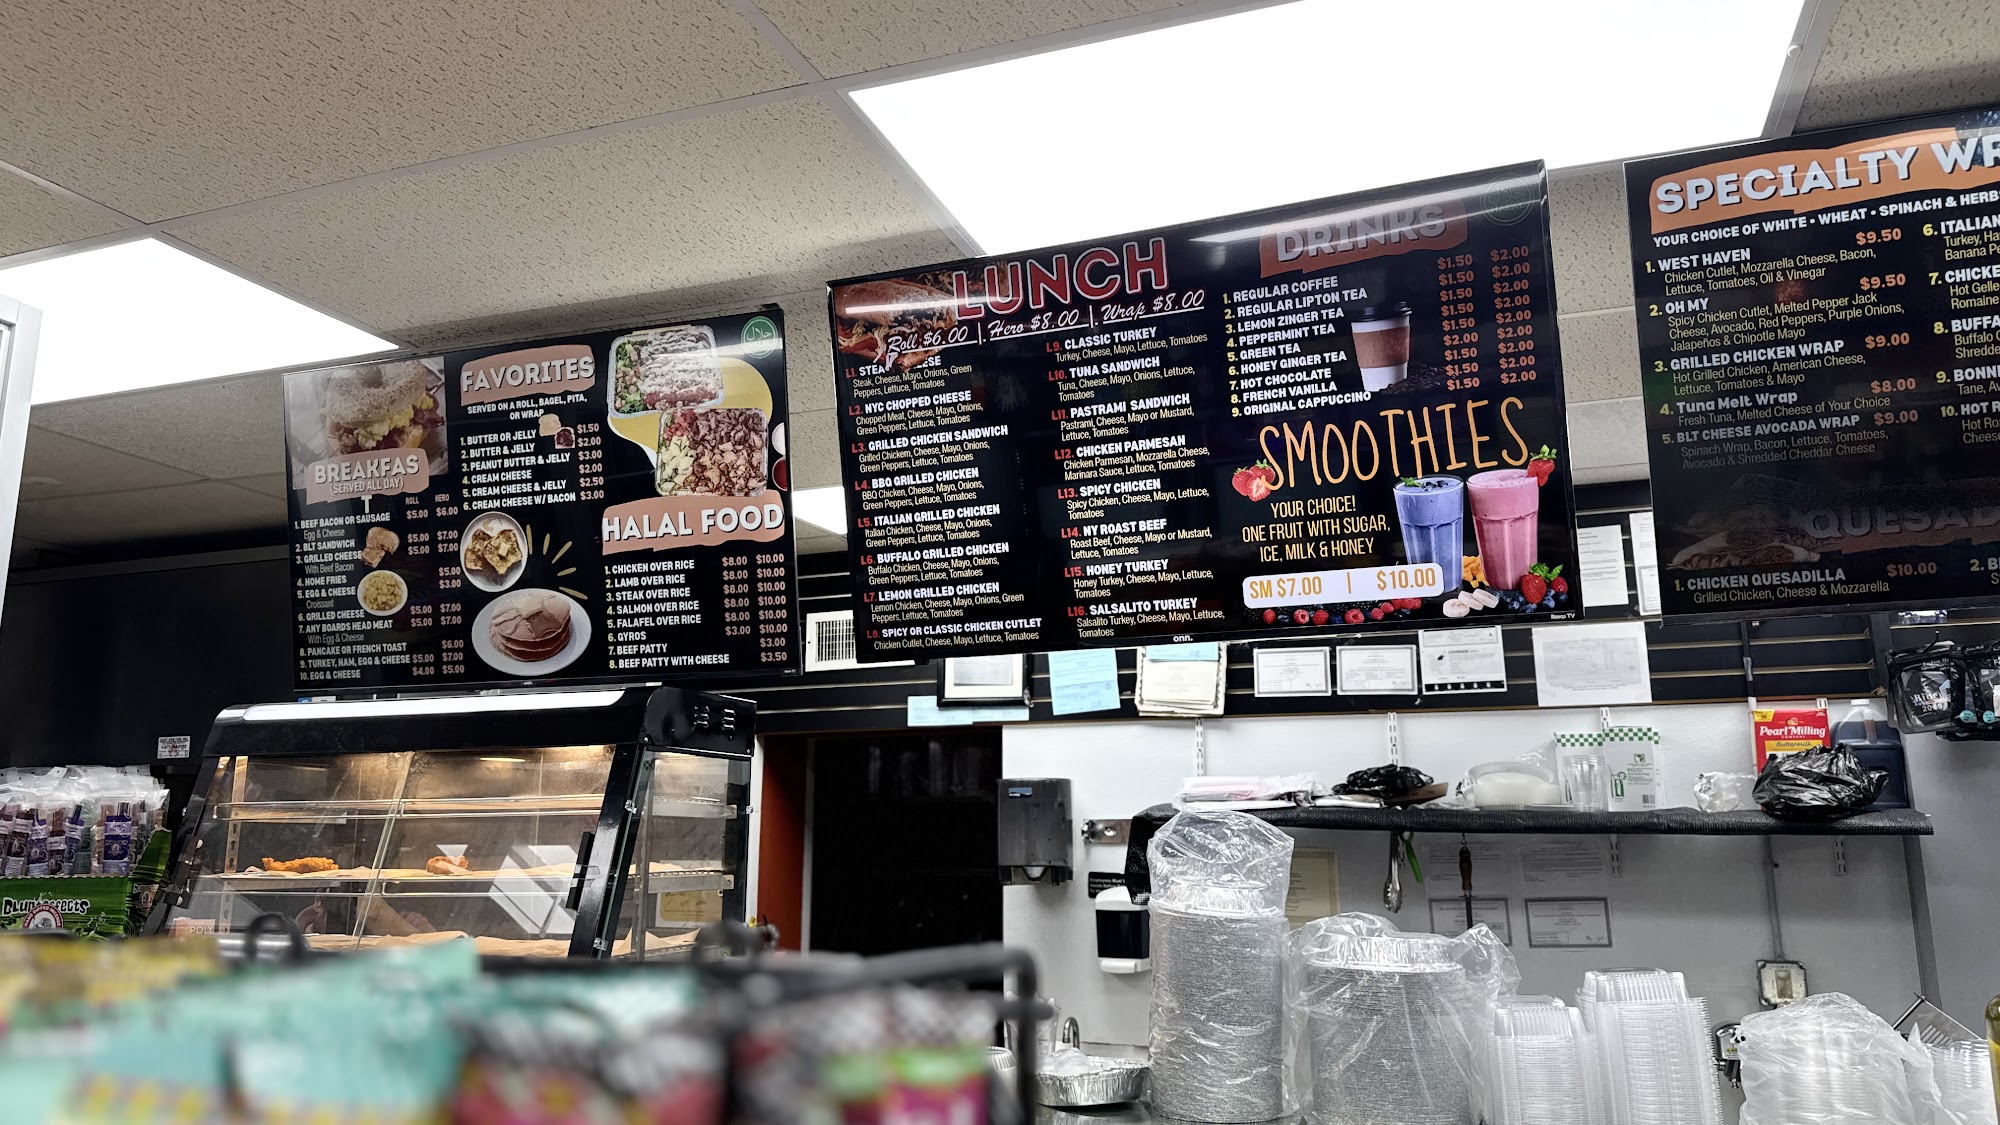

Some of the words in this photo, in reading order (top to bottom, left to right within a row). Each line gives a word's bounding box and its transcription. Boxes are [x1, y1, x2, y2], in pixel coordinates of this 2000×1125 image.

[1656, 146, 1918, 214] SPECIALTY
[1653, 235, 1689, 248] YOUR
[1691, 227, 1739, 244] CHOICE
[1742, 224, 1759, 236] OF
[1762, 217, 1807, 233] WHITE
[1818, 208, 1867, 225] WHEAT
[1879, 197, 1942, 216] SPINACH
[1945, 196, 1957, 207] &
[1960, 190, 2000, 206] HERB
[1276, 204, 1448, 262] DRINKS
[1856, 228, 1902, 246] $9.50
[1645, 262, 1656, 273] 1.
[1658, 256, 1699, 272] WEST
[1702, 248, 1750, 265] HAVEN
[953, 236, 1169, 320] LUNCH
[1223, 294, 1231, 304] 1.
[1233, 285, 1289, 303] REGULAR
[1292, 276, 1338, 294] COFFEE
[1438, 255, 1473, 270] $1.50
[1491, 246, 1529, 262] $2.00
[887, 333, 917, 354] Roll
[923, 326, 968, 346] $6.00
[988, 320, 1024, 337] Hero
[1031, 309, 1079, 330] $8.00
[1101, 301, 1146, 320] Wrap
[1153, 290, 1205, 312] $8.00
[462, 357, 594, 392] FAVORITES
[1048, 372, 1067, 381] L10.
[1070, 367, 1099, 378] TUNA
[1102, 356, 1160, 374] SANDWICH
[468, 404, 496, 414] SERVED
[516, 400, 538, 409] ROLL,
[539, 396, 566, 406] BAGEL,
[567, 394, 587, 403] PITA,
[510, 412, 520, 420] OR
[522, 409, 544, 418] WRAP
[849, 405, 862, 416] L2.
[865, 402, 884, 414] NYC
[886, 395, 931, 410] CHOPPED
[933, 390, 972, 404] CHEESE
[856, 414, 886, 426] Chopped
[888, 410, 906, 420] Meat,
[908, 408, 934, 418] Cheese,
[936, 406, 955, 417] Mayo,
[957, 403, 983, 414] Onions,
[1232, 406, 1242, 417] 9.
[1244, 400, 1296, 416] ORIGINAL
[1298, 391, 1372, 409] CAPPUCCINO
[1660, 403, 1673, 415] 4.
[1677, 400, 1715, 414] Tuna
[1718, 395, 1751, 409] Melt
[1755, 391, 1798, 406] Wrap
[460, 438, 466, 446] 1.
[467, 435, 498, 445] BUTTER
[500, 433, 511, 441] OR
[513, 430, 536, 440] JELLY
[577, 424, 599, 434] $1.50
[1260, 396, 1528, 490] SMOOTHIES
[314, 455, 419, 484] BREAKFAS
[855, 481, 870, 490] L4.
[872, 478, 892, 489] BBQ
[894, 473, 934, 485] GRILLED
[936, 468, 979, 481] CHICKEN
[330, 482, 364, 496] (SERVED
[367, 481, 382, 490] ALL
[384, 477, 404, 490] DAY)
[361, 495, 372, 513] T
[406, 496, 419, 505] ROLL
[463, 502, 471, 510] 6.
[472, 500, 500, 510] CREAM
[502, 497, 532, 507] CHEESE
[534, 495, 545, 504] W/
[548, 492, 576, 503] BACON
[580, 490, 604, 500] $3.00
[1271, 500, 1304, 518] YOUR
[1307, 495, 1356, 514] CHOICE!
[294, 521, 300, 529] 1.
[301, 519, 318, 529] BEEF
[320, 517, 343, 527] BACON
[356, 512, 390, 524] SAUSAGE
[406, 509, 428, 519] $5.00
[436, 507, 458, 516] $6.00
[602, 512, 693, 541] HALAL
[702, 504, 783, 534] FOOD
[1242, 524, 1266, 542] ONE
[1269, 521, 1303, 539] FRUIT
[1306, 518, 1340, 538] WITH
[1343, 514, 1390, 534] SUGAR,
[304, 530, 315, 541] Egg
[316, 530, 321, 538] &
[322, 529, 345, 538] Cheese
[1260, 545, 1283, 563] ICE,
[1286, 542, 1316, 560] MILK
[1319, 540, 1328, 558] &
[1332, 537, 1374, 556] HONEY
[605, 566, 611, 575] 1.
[612, 562, 648, 574] CHICKEN
[650, 561, 674, 571] OVER
[676, 560, 694, 570] RICE
[722, 556, 747, 566] $8.00
[756, 554, 784, 564] $10.00
[1887, 562, 1937, 576] $10.00
[1250, 579, 1272, 599] SM
[1276, 575, 1322, 597] $7.00
[1376, 568, 1436, 590] $10.00
[1675, 580, 1684, 591] 1.
[1687, 574, 1748, 590] CHICKEN
[1752, 568, 1846, 586] QUESADILLA
[1068, 607, 1087, 616] L16.
[1090, 602, 1151, 615] SALSALITO
[1153, 598, 1197, 610] TURKEY
[867, 630, 880, 639] L8.
[882, 628, 908, 638] SPICY
[910, 627, 922, 635] OR
[924, 624, 962, 634] CLASSIC
[964, 622, 1003, 632] CHICKEN
[1005, 618, 1042, 629] CUTLET
[609, 660, 617, 669] 8.
[619, 657, 640, 668] BEEF
[642, 656, 670, 666] PATTY
[671, 656, 693, 665] WITH
[695, 654, 730, 664] CHEESE
[761, 652, 787, 662] $3.50
[310, 672, 324, 680] EGG
[333, 670, 360, 678] CHEESE
[413, 667, 434, 676] $4.00
[442, 665, 464, 674] $5.00
[1760, 726, 1787, 736] Pearl
[1789, 726, 1826, 738] Milling
